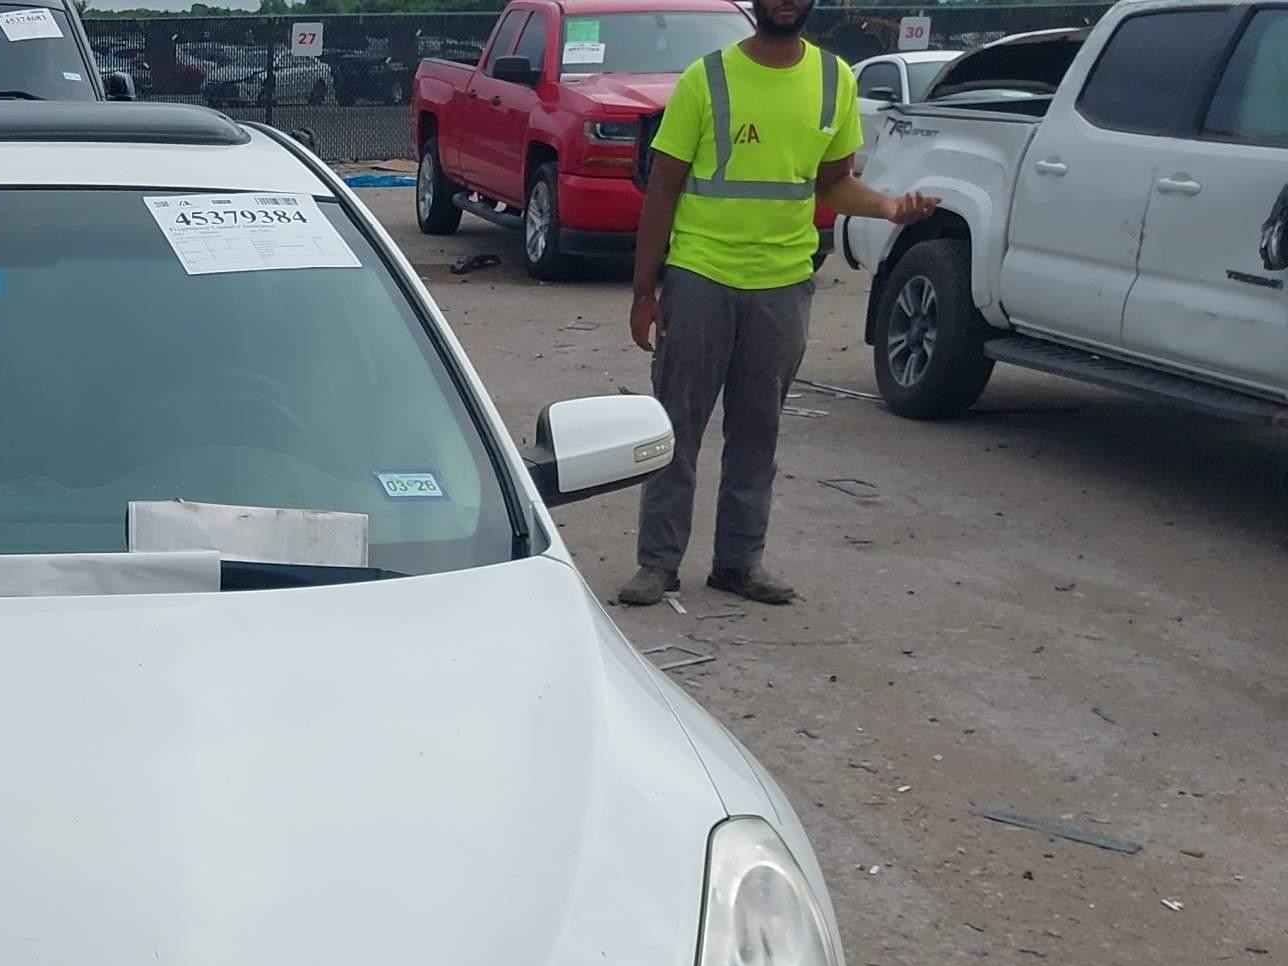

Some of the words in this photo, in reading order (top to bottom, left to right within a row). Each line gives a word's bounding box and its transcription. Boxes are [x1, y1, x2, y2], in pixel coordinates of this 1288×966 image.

[298, 32, 317, 45] 27
[905, 26, 924, 39] 30
[175, 209, 308, 226] 45379384
[386, 479, 408, 492] 03
